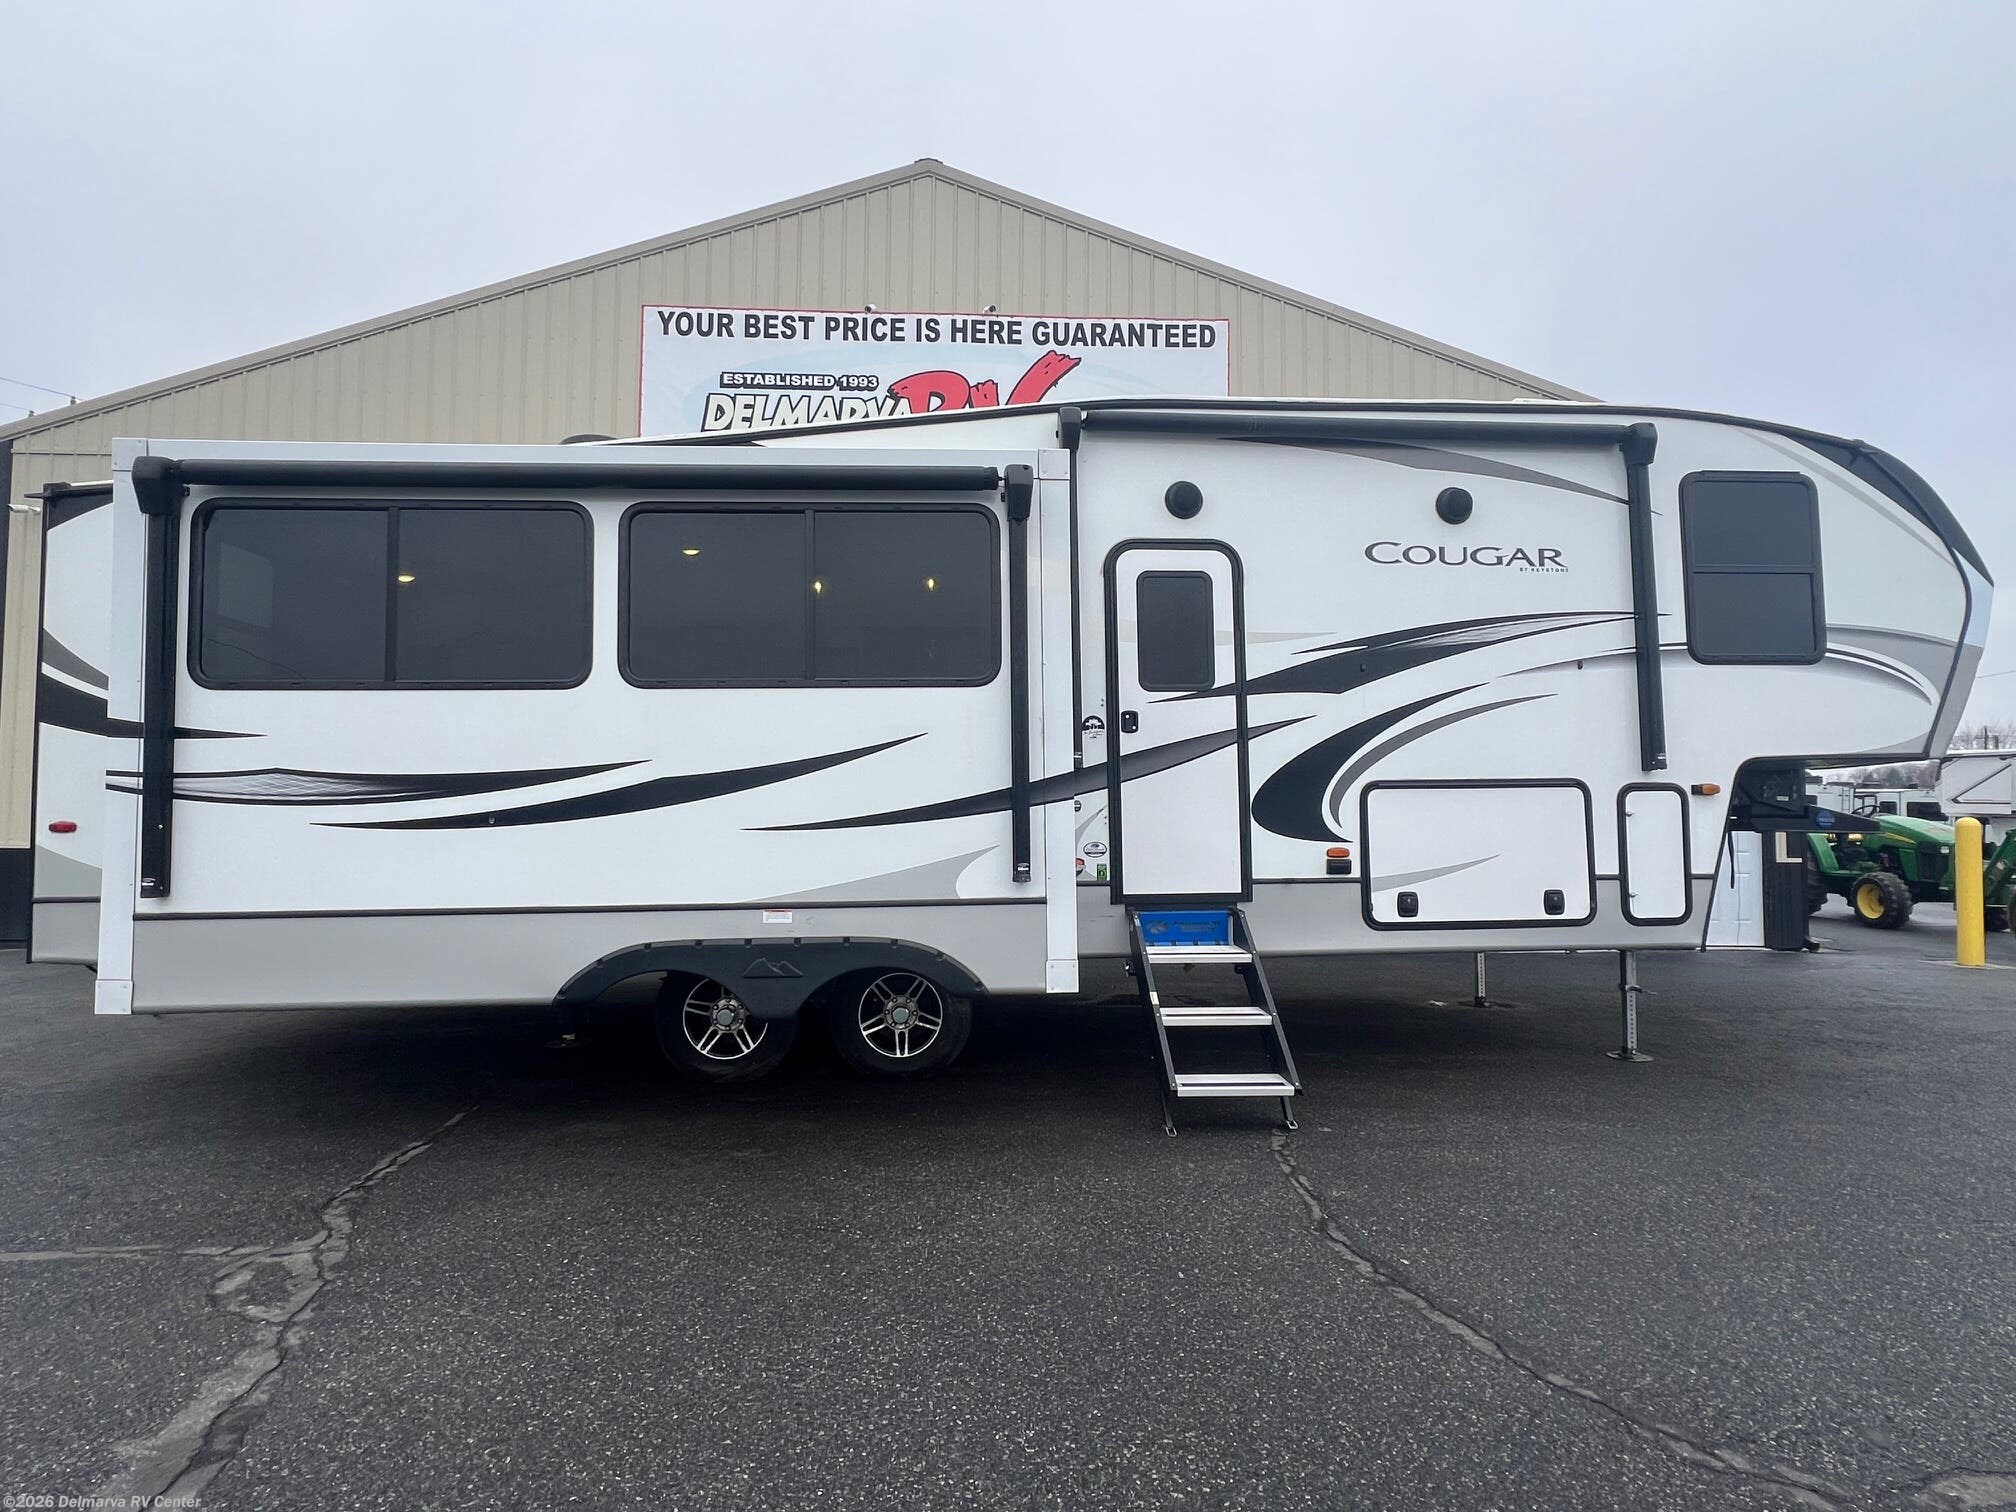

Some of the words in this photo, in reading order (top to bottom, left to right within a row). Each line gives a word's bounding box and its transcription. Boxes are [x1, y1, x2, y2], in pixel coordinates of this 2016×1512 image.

[657, 311, 735, 338] YOUR
[744, 314, 815, 340] BEST
[825, 316, 906, 342] PRICE
[916, 318, 941, 343] IS
[951, 319, 1023, 345] HERE
[1032, 322, 1216, 348] GUARANTEED
[722, 373, 836, 387] ESTABLISHED
[840, 376, 878, 388] 1993
[1364, 541, 1568, 568] COUGAR
